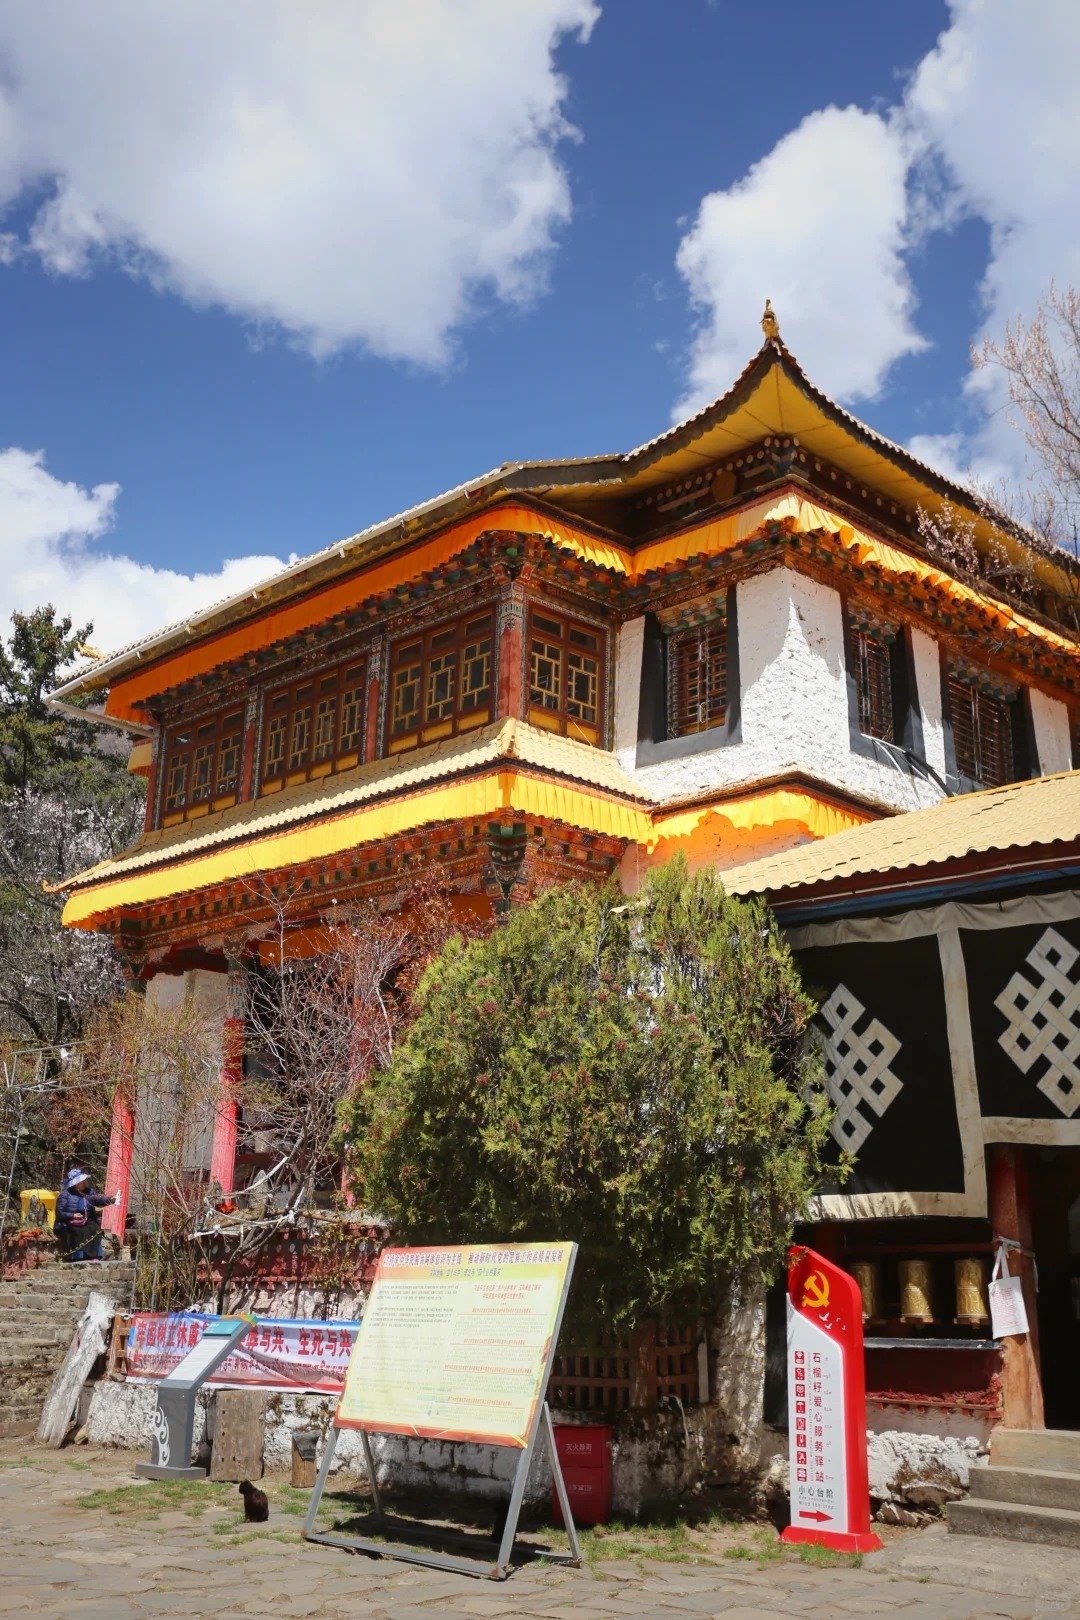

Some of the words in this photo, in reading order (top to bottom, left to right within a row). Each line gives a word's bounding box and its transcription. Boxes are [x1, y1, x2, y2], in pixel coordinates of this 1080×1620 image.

[137, 1320, 208, 1348] 牢固树立休戚
[241, 1325, 352, 1357] 辱与共、生死与共
[812, 1352, 824, 1482] 石榴籽爱心服务驿站
[798, 1485, 834, 1498] 小心台阶
